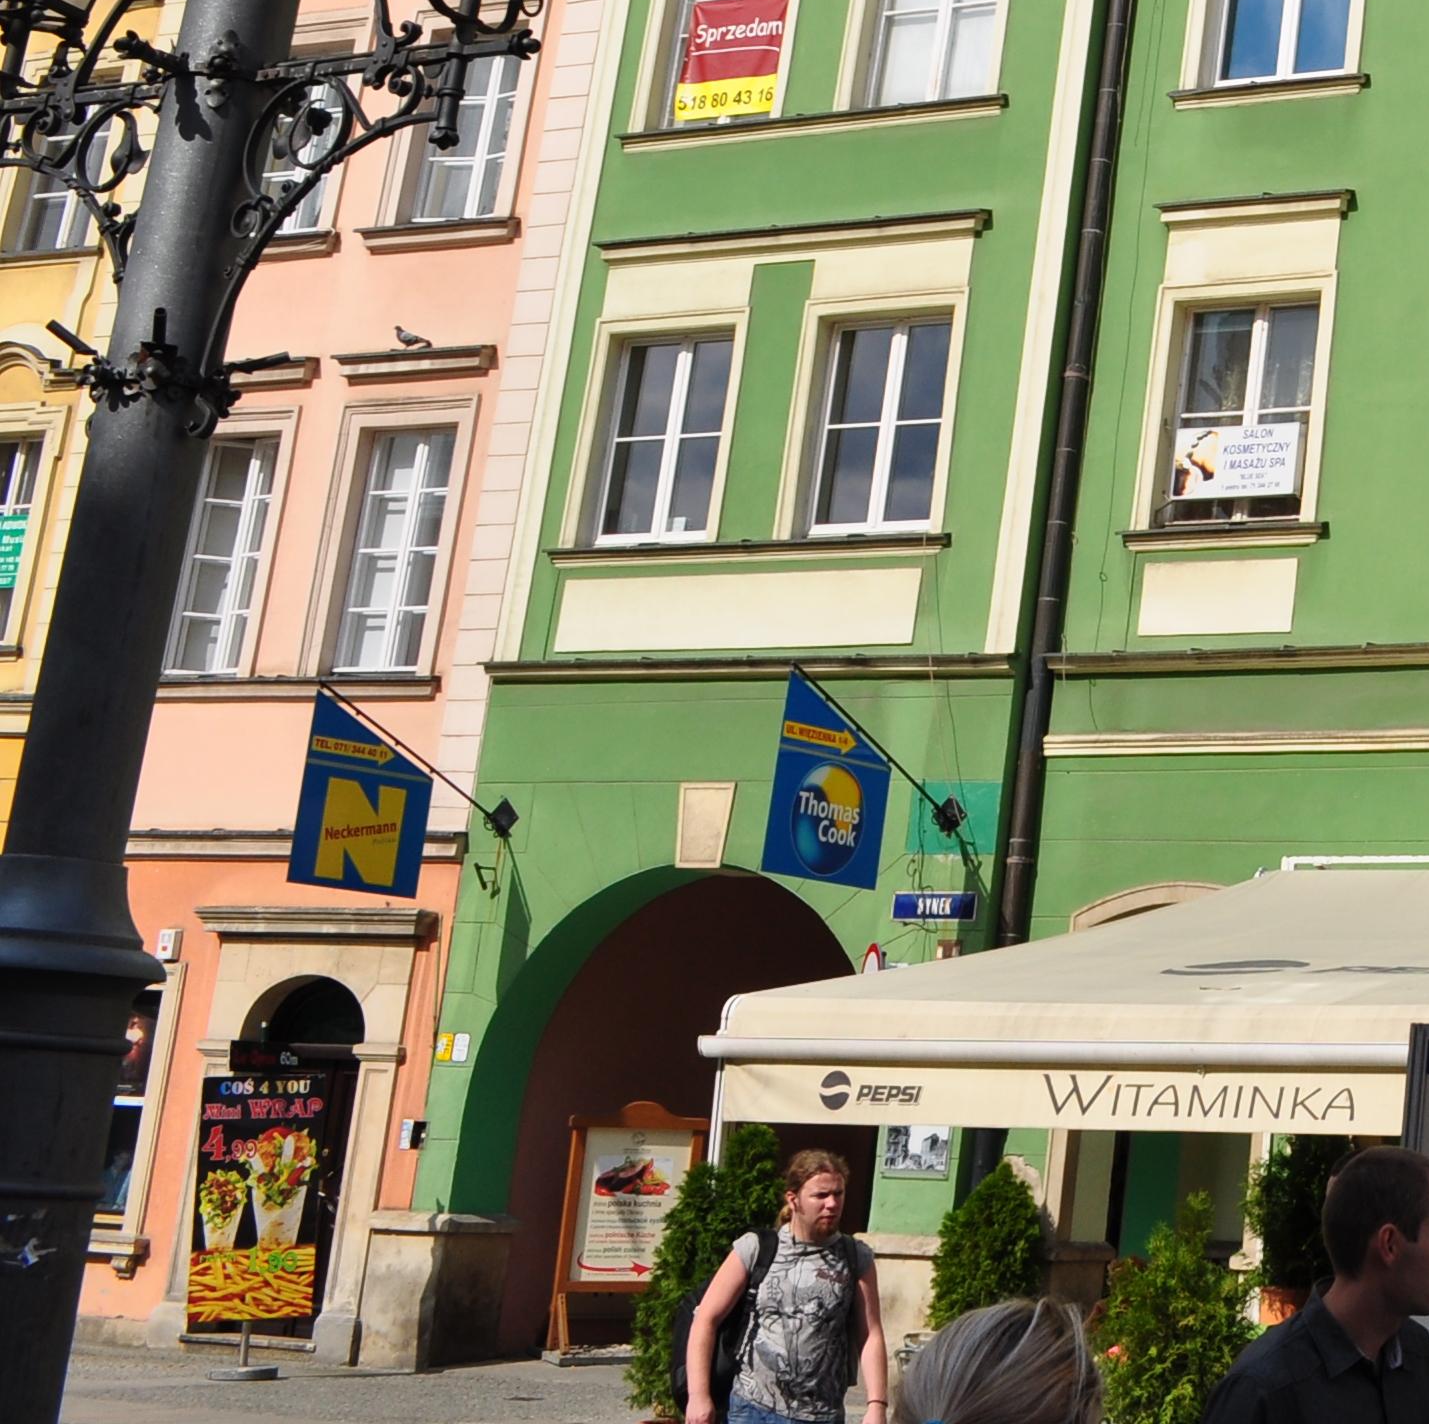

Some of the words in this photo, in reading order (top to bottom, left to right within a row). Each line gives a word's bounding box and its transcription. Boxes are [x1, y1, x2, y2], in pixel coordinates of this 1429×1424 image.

[695, 17, 783, 47] Sprzedam
[711, 92, 728, 107] 80
[733, 89, 752, 105] 43
[758, 86, 773, 102] 16
[1243, 428, 1274, 440] SALON
[1223, 441, 1291, 456] KOSMETYCZNY
[1269, 457, 1286, 468] SPA
[799, 790, 860, 824] Thomas
[324, 821, 398, 841] Neckermann
[818, 819, 857, 847] Cook
[220, 1078, 254, 1094] COŚ
[259, 1080, 269, 1093] 4
[276, 1079, 311, 1094] YOU
[855, 1084, 922, 1105] PEPSI
[203, 1103, 242, 1120] Mini
[248, 1097, 324, 1119] WRAP
[202, 1125, 258, 1164] 4,99
